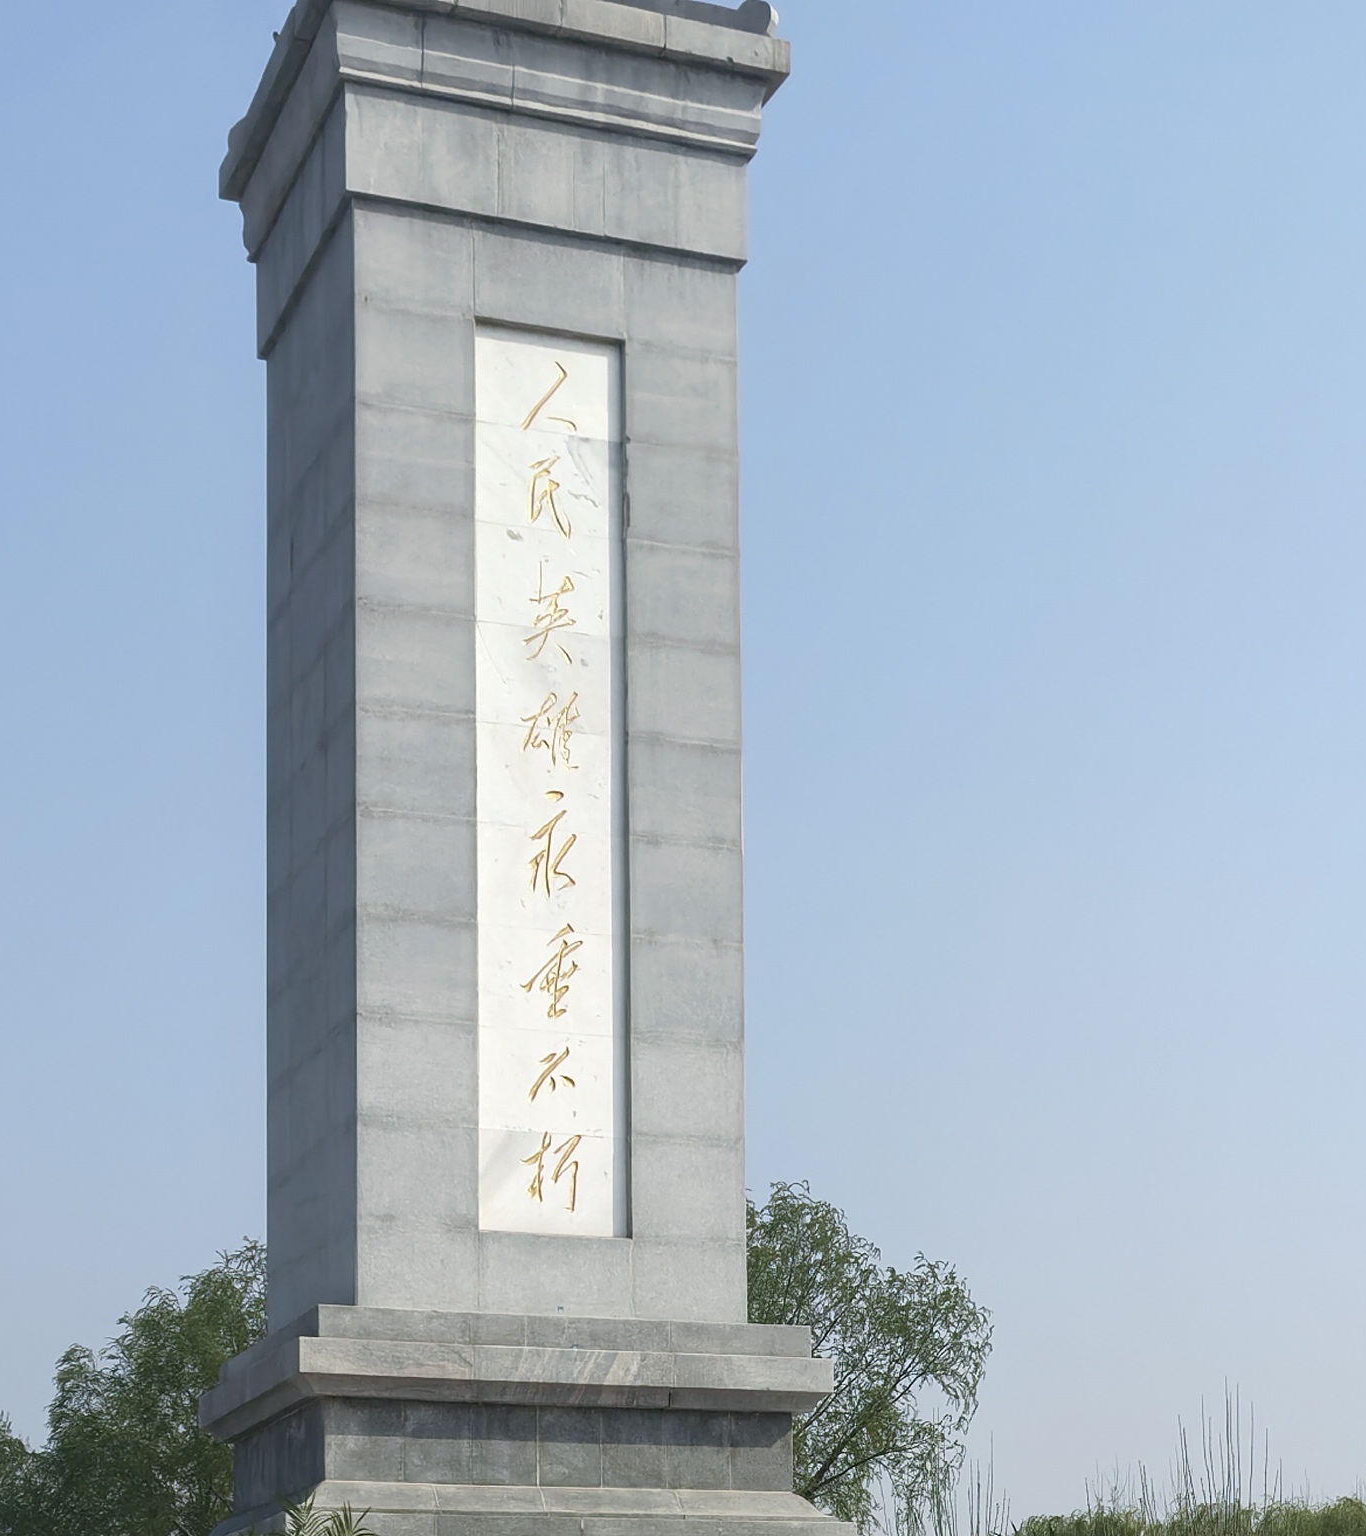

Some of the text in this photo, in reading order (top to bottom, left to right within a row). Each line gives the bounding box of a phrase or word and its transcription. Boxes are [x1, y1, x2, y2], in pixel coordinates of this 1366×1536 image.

[519, 360, 584, 1213] 人民英雄永垂不朽
